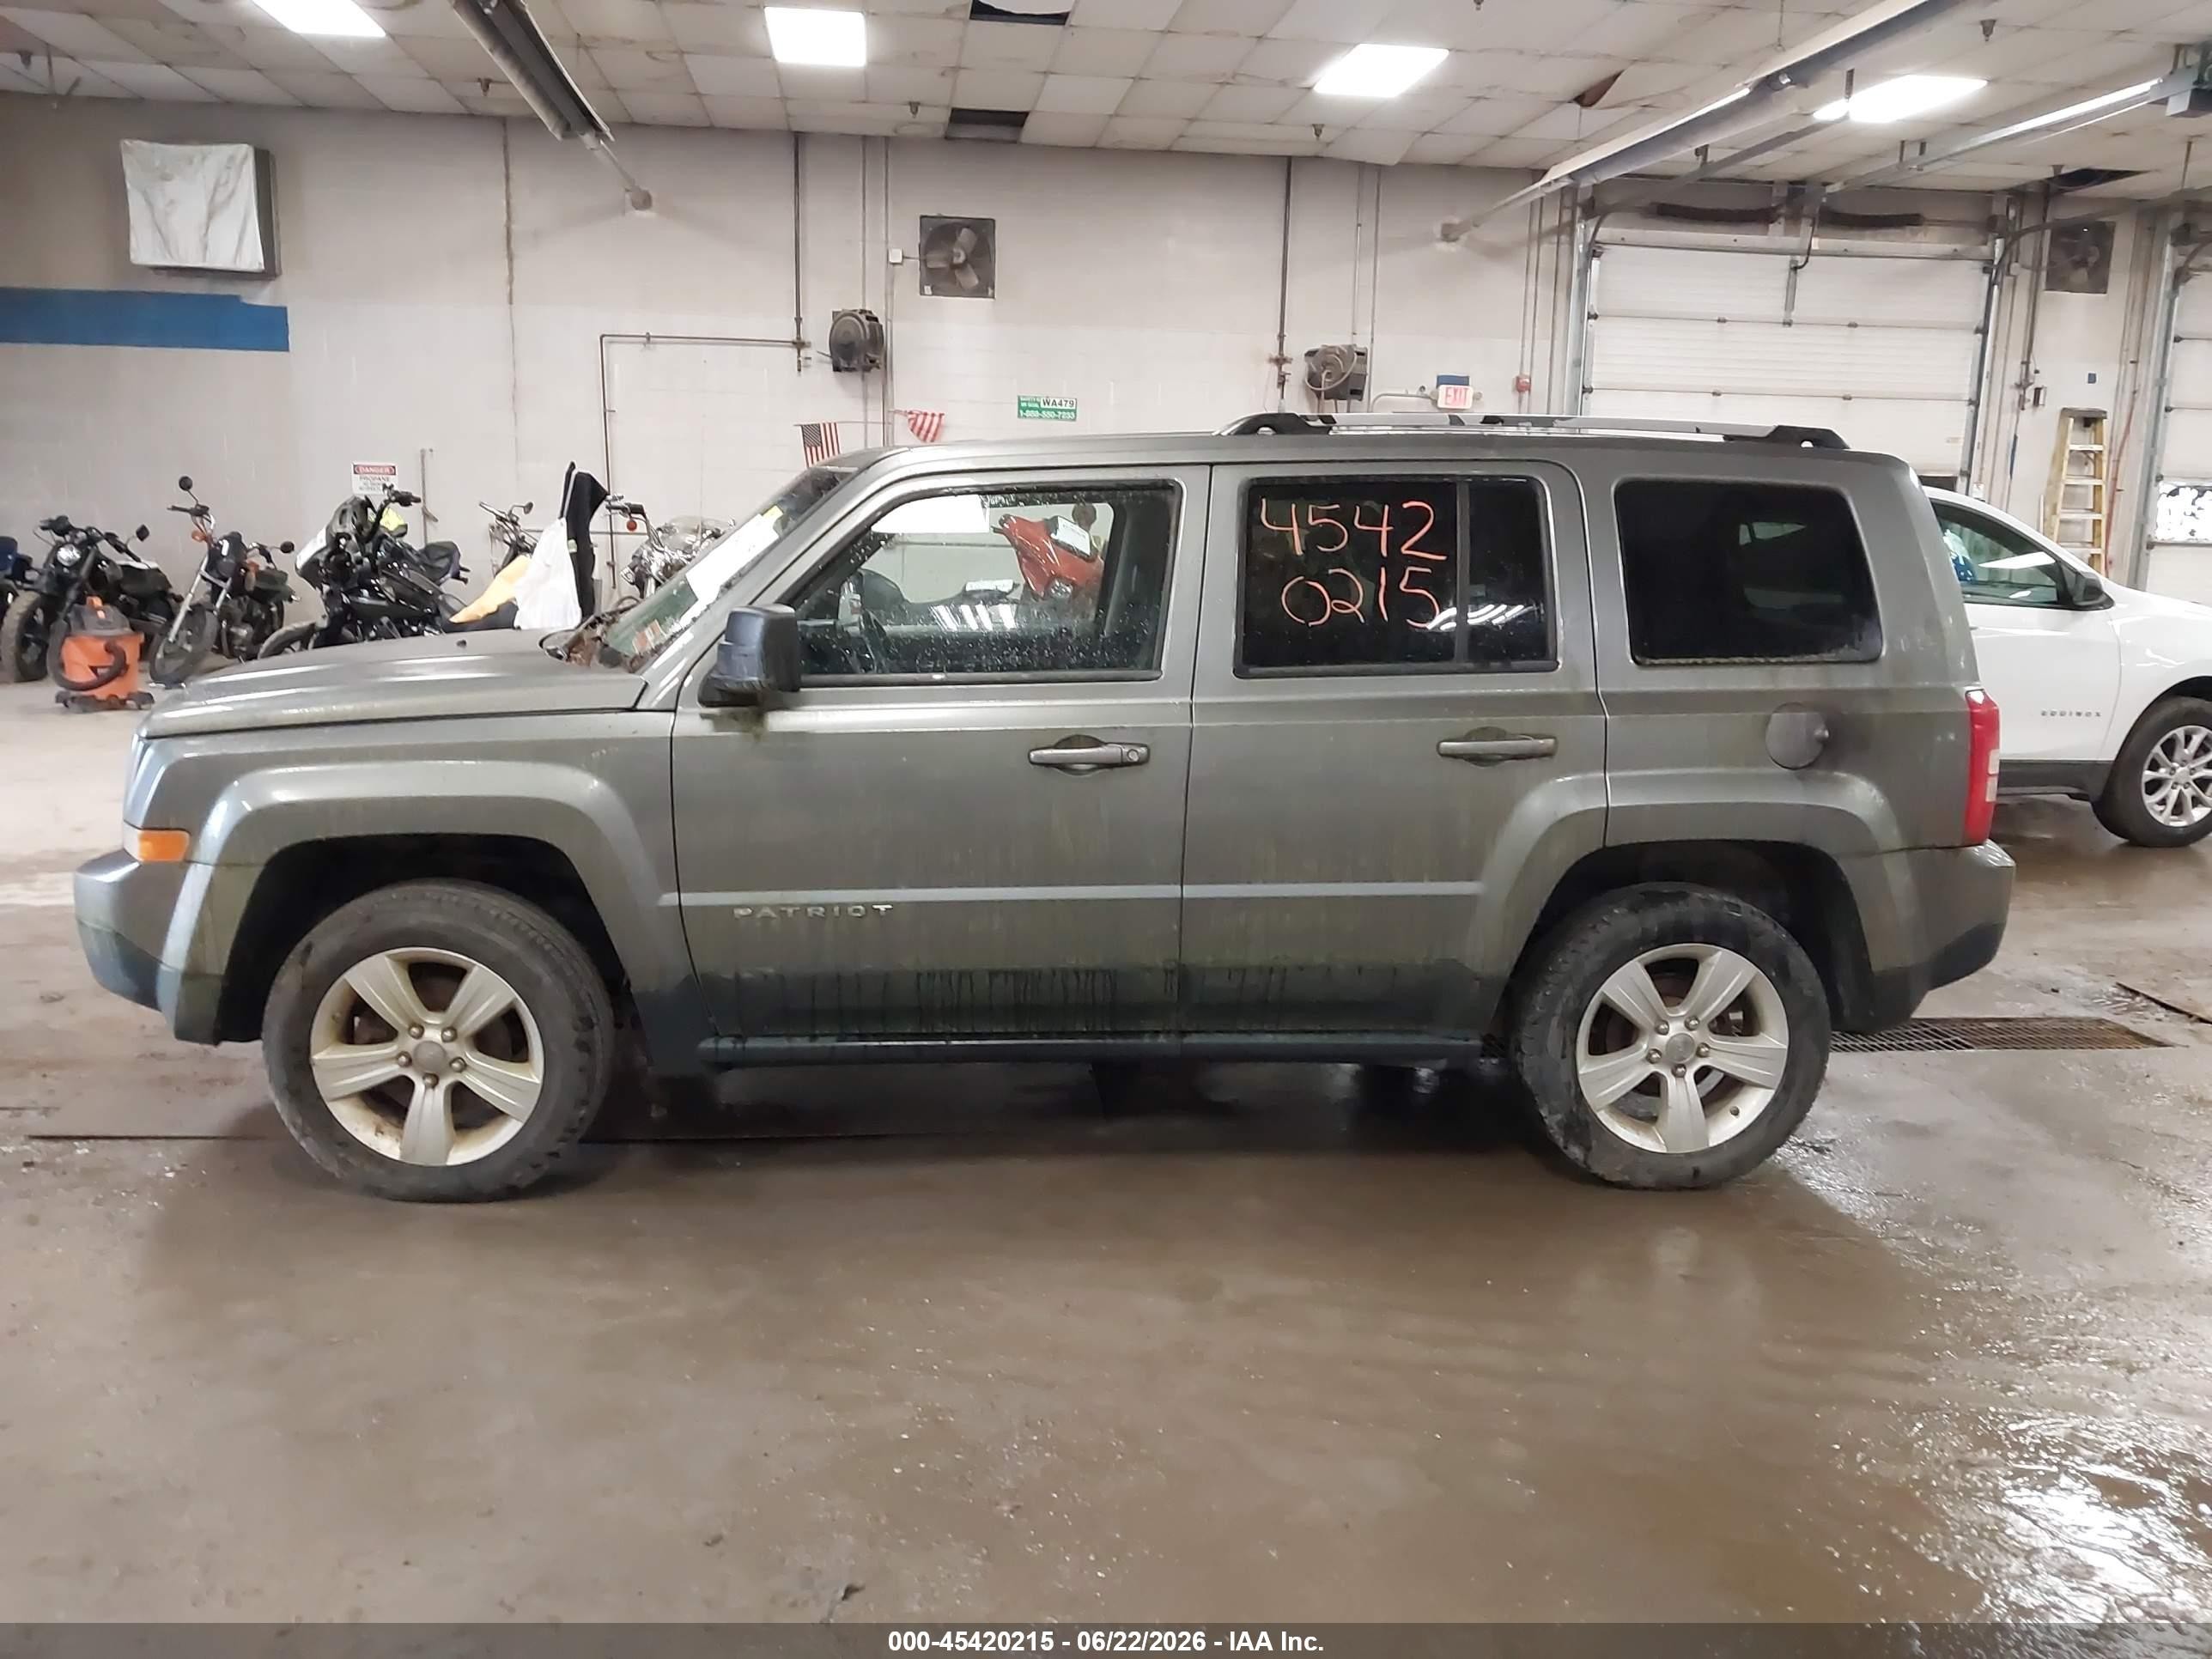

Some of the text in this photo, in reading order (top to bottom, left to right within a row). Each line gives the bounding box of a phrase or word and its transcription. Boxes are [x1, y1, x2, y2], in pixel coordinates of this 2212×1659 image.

[1042, 398, 1074, 408] WA479
[1445, 386, 1469, 406] EXIT
[1261, 496, 1448, 560] 4542
[1281, 566, 1441, 629] 0215
[732, 904, 894, 919] PATRIOT
